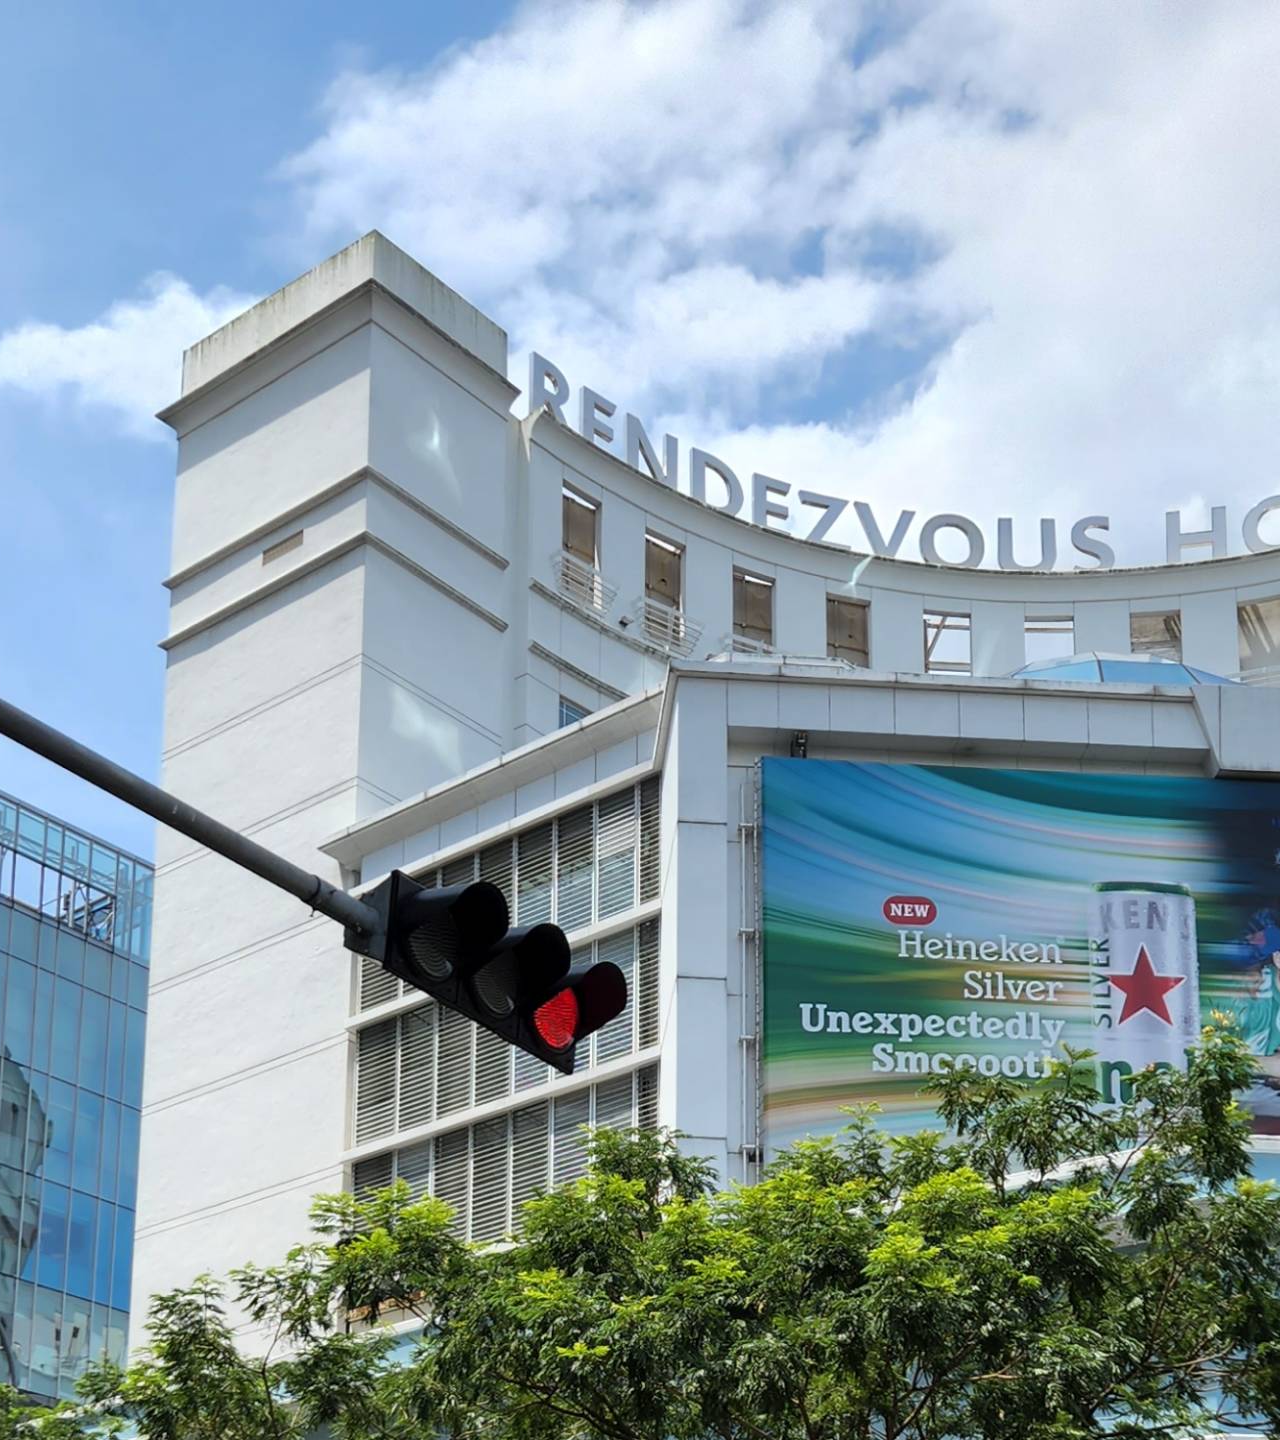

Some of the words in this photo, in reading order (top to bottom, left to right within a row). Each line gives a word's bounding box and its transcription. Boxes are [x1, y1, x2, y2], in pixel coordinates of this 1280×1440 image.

[529, 351, 1114, 573] RENDEZVOUS
[889, 903, 930, 918] NEW
[897, 930, 1063, 964] Heineken
[963, 970, 1063, 1001] Silver
[1091, 938, 1112, 1029] SILVER
[799, 1003, 1066, 1048] Unexpectedly
